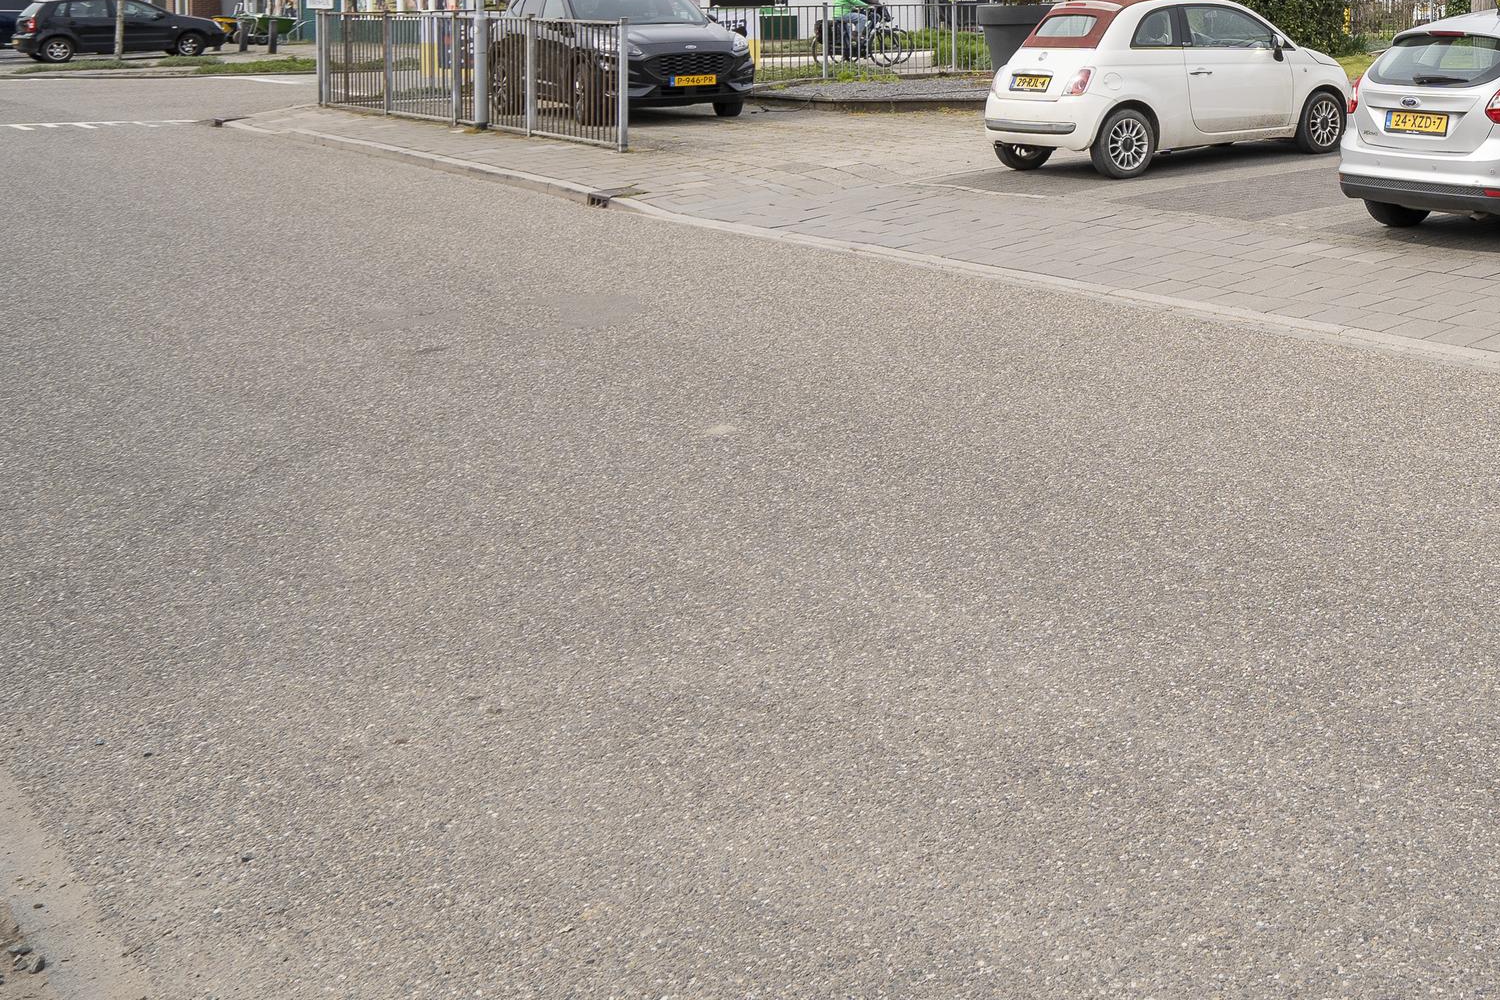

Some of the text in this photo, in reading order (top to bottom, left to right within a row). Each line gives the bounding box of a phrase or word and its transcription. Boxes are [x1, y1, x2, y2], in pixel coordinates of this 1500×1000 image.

[677, 76, 714, 85] P-946-PR
[1016, 77, 1047, 88] 29-RJL-4
[1394, 113, 1444, 131] 24-XZD-7
